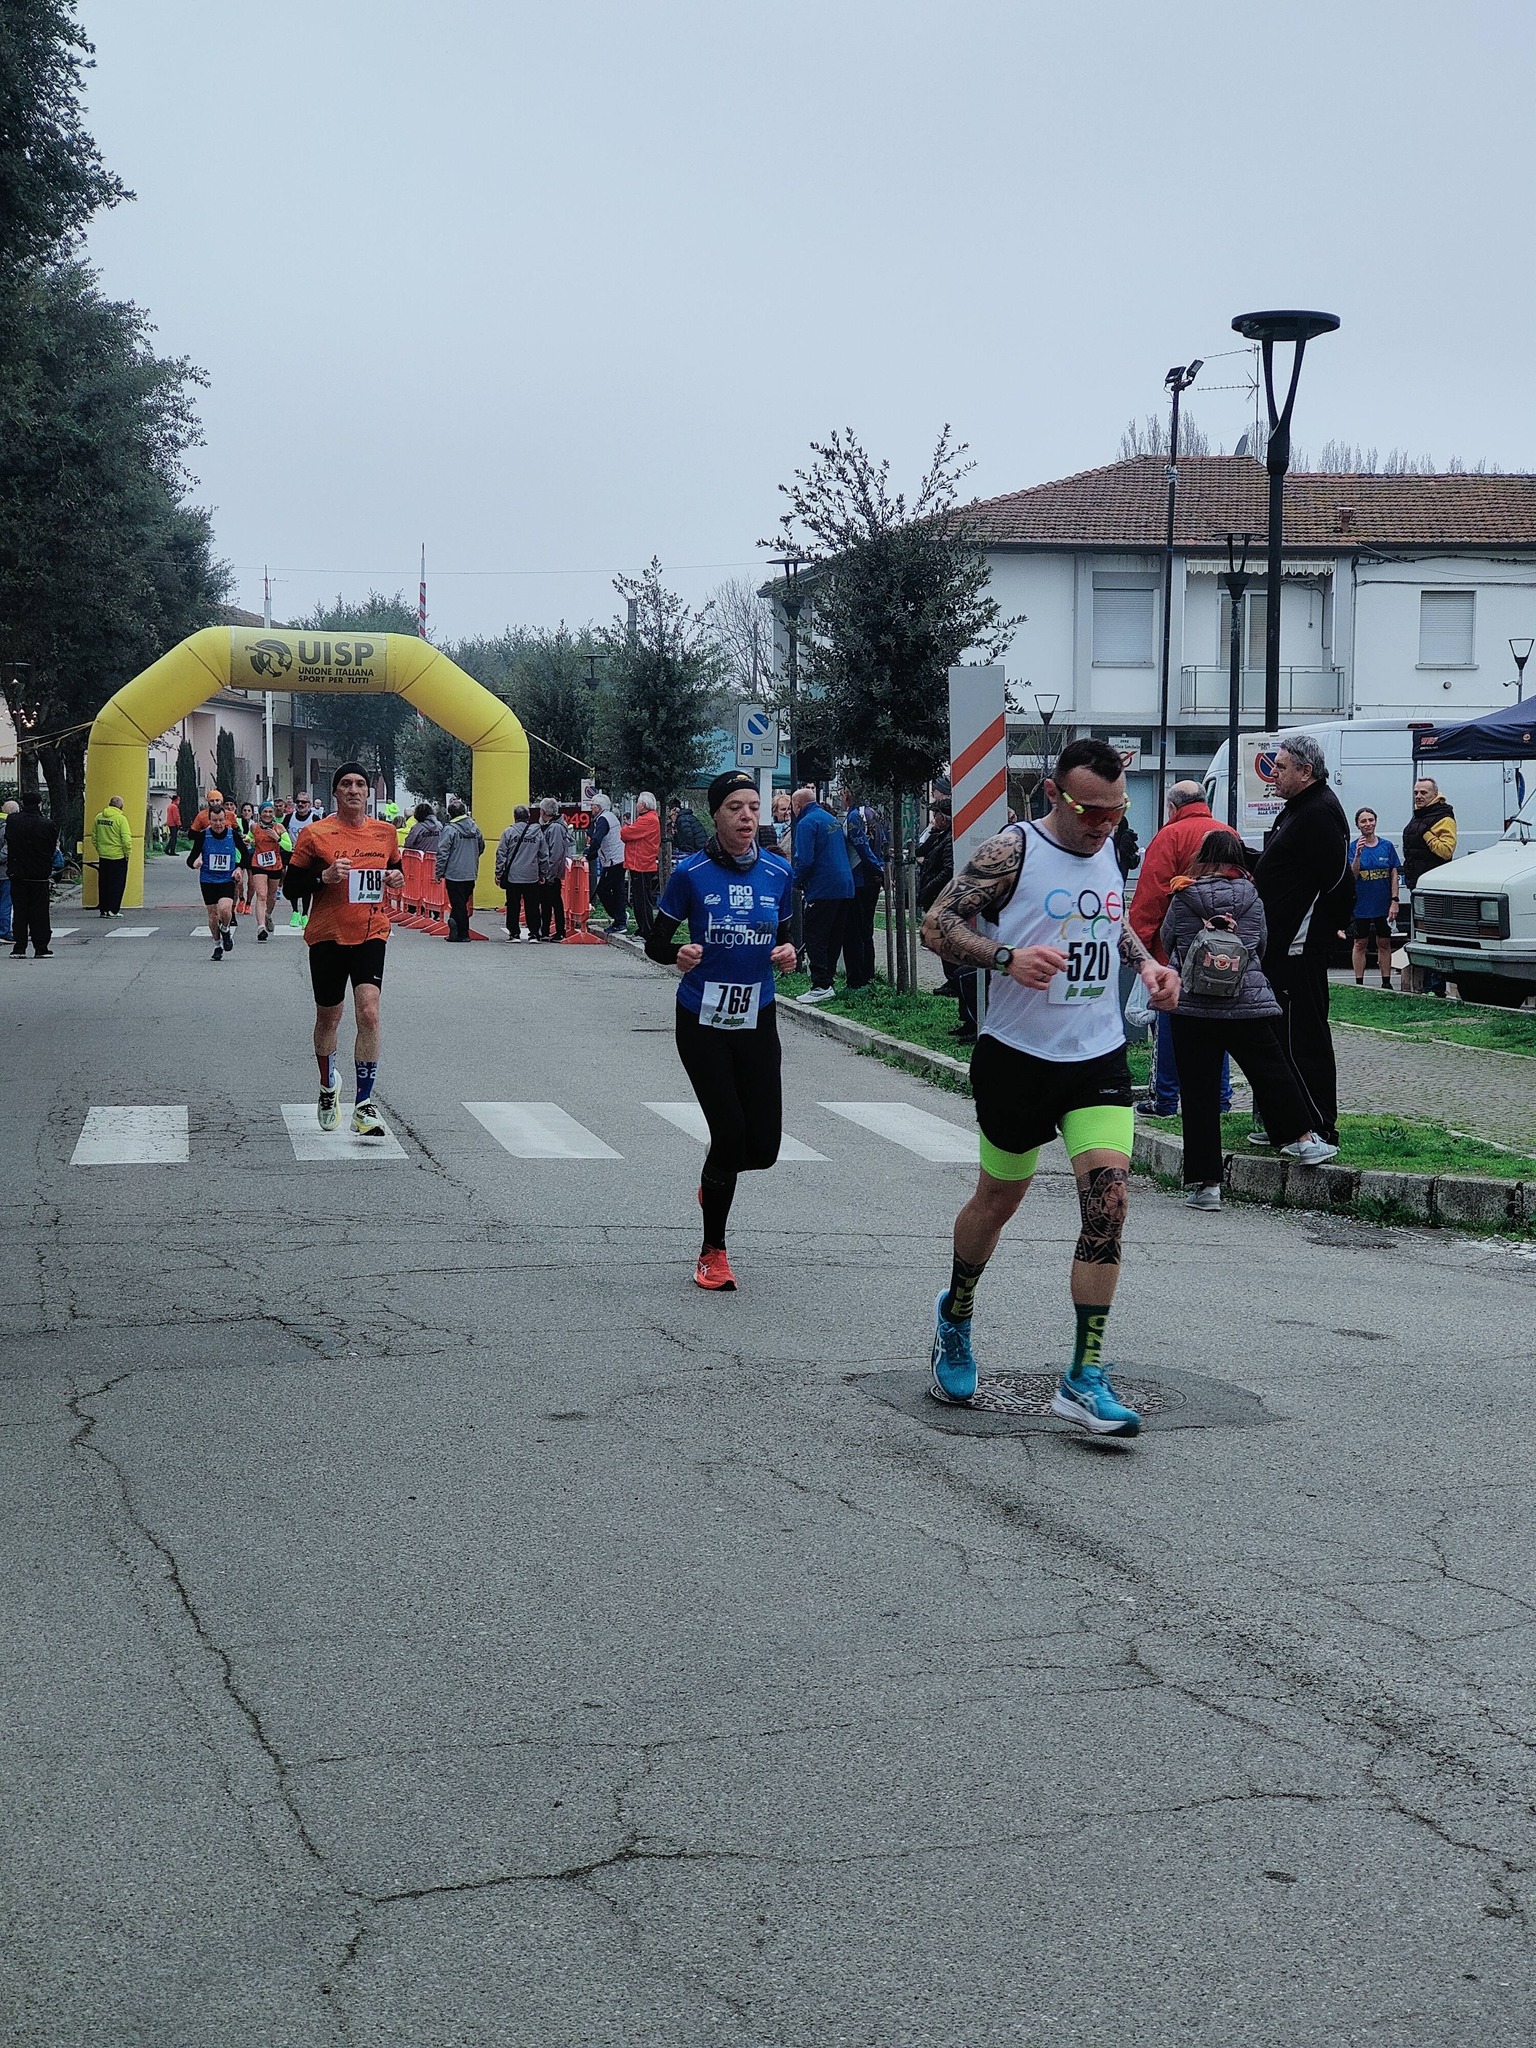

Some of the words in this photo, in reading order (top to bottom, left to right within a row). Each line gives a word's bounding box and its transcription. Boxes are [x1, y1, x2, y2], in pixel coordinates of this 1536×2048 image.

[298, 640, 374, 667] UISP
[298, 667, 332, 676] UNIONE
[335, 668, 374, 677] ITALIANA
[298, 675, 326, 683] SPORT
[328, 675, 344, 684] PER
[347, 676, 369, 684] TUTTI
[743, 744, 751, 753] P
[213, 855, 227, 866] 704
[358, 870, 382, 891] 788
[729, 884, 753, 896] PRO
[708, 929, 772, 949] LugoRun
[1067, 941, 1110, 982] 520
[716, 984, 753, 1015] 769
